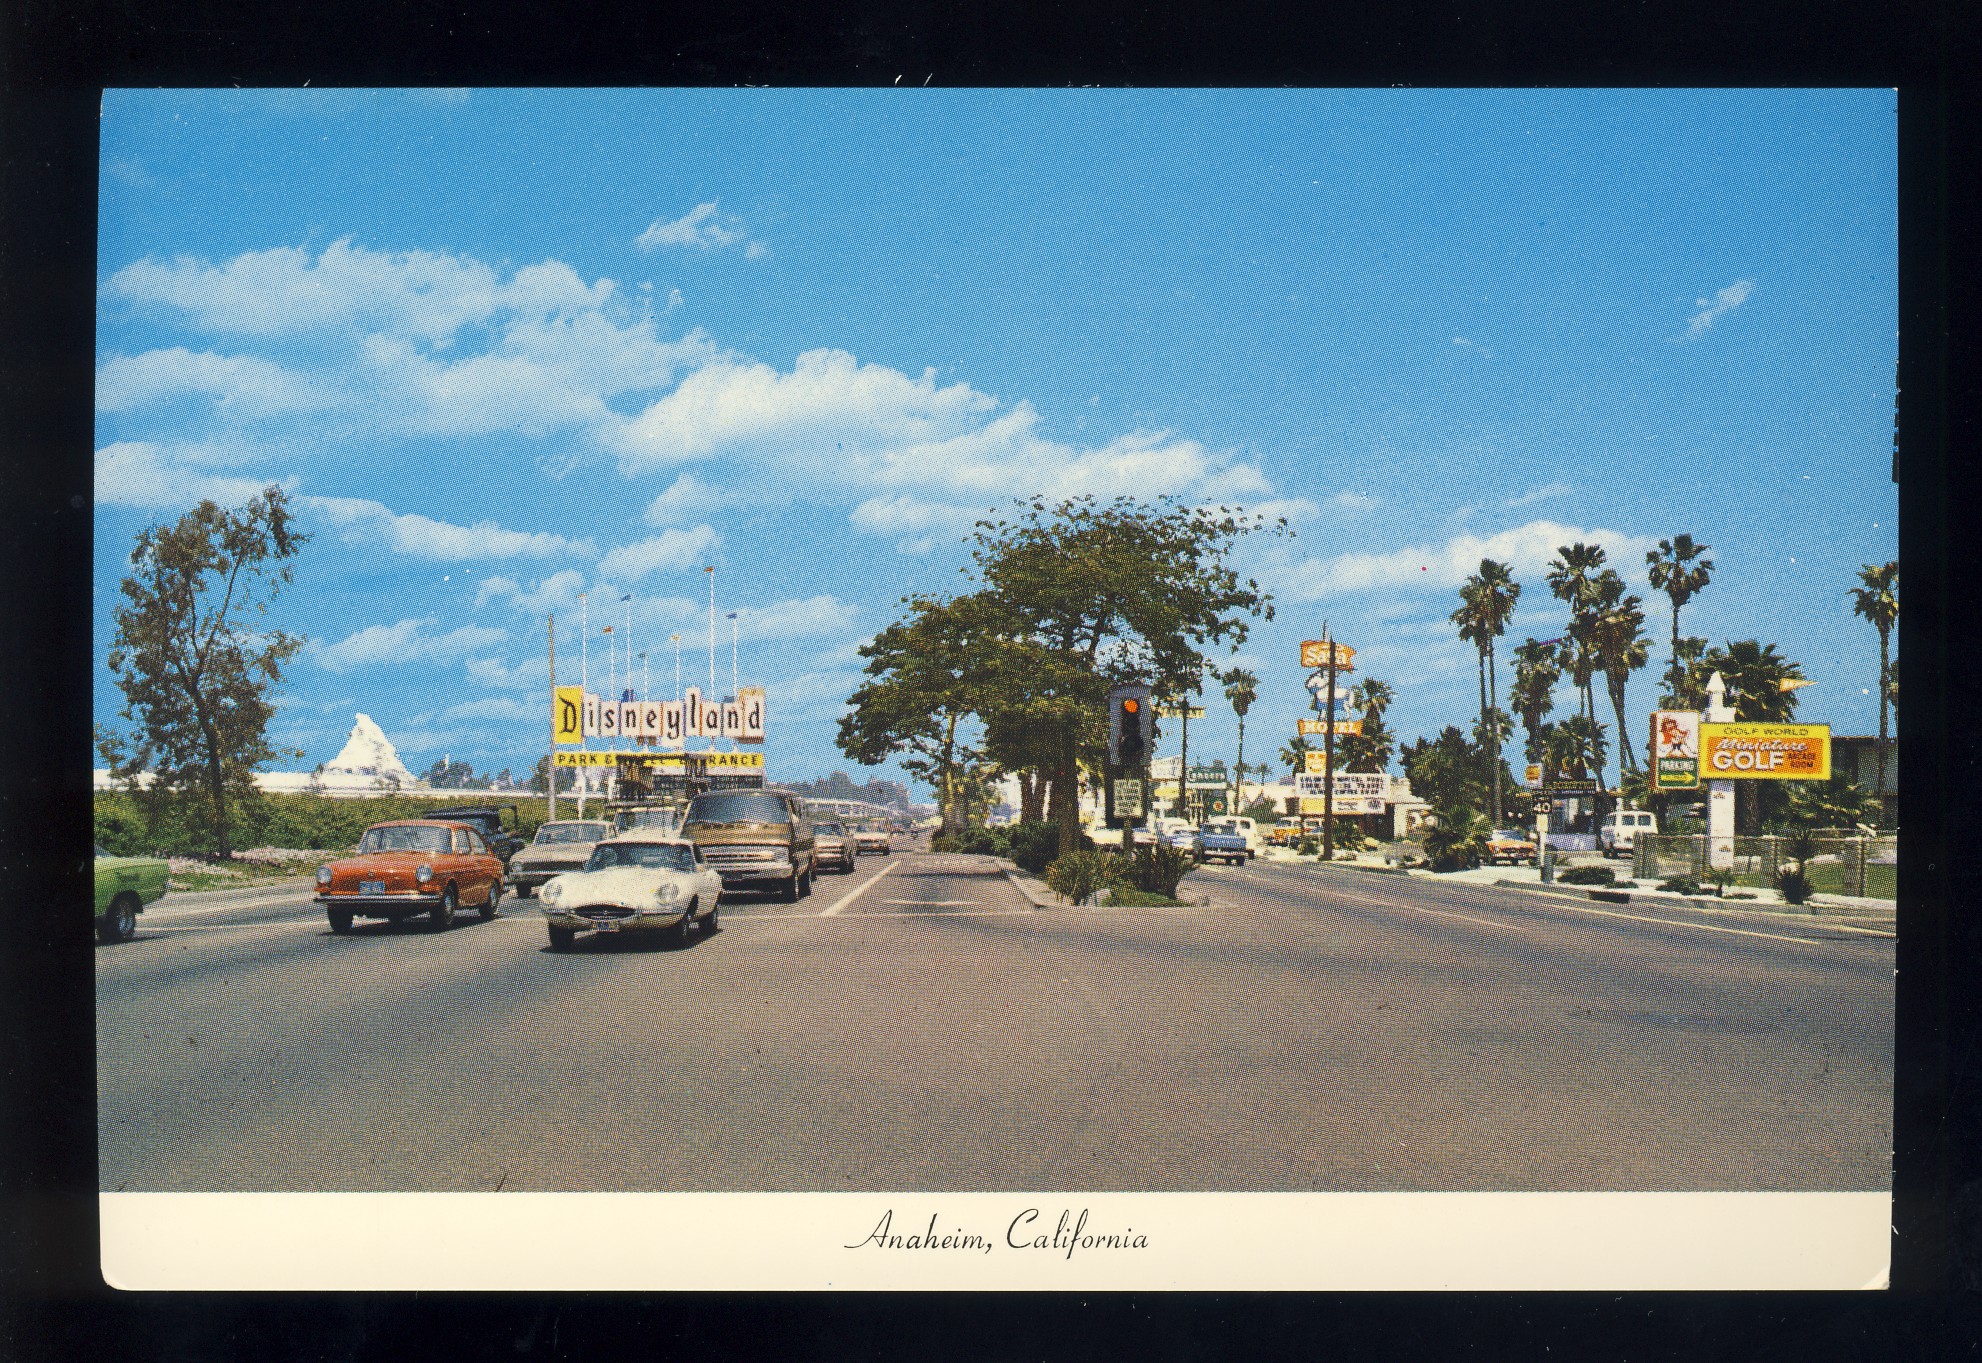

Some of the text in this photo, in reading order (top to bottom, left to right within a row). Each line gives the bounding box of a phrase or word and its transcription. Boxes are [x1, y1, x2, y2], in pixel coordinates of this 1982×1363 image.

[1306, 645, 1348, 666] Saa
[557, 693, 761, 741] Disneyland
[1304, 721, 1357, 734] MOEL
[1723, 727, 1809, 736] GOLF WORLD
[558, 753, 598, 764] PARK
[604, 754, 613, 764] &
[1712, 750, 1784, 771] GOLF
